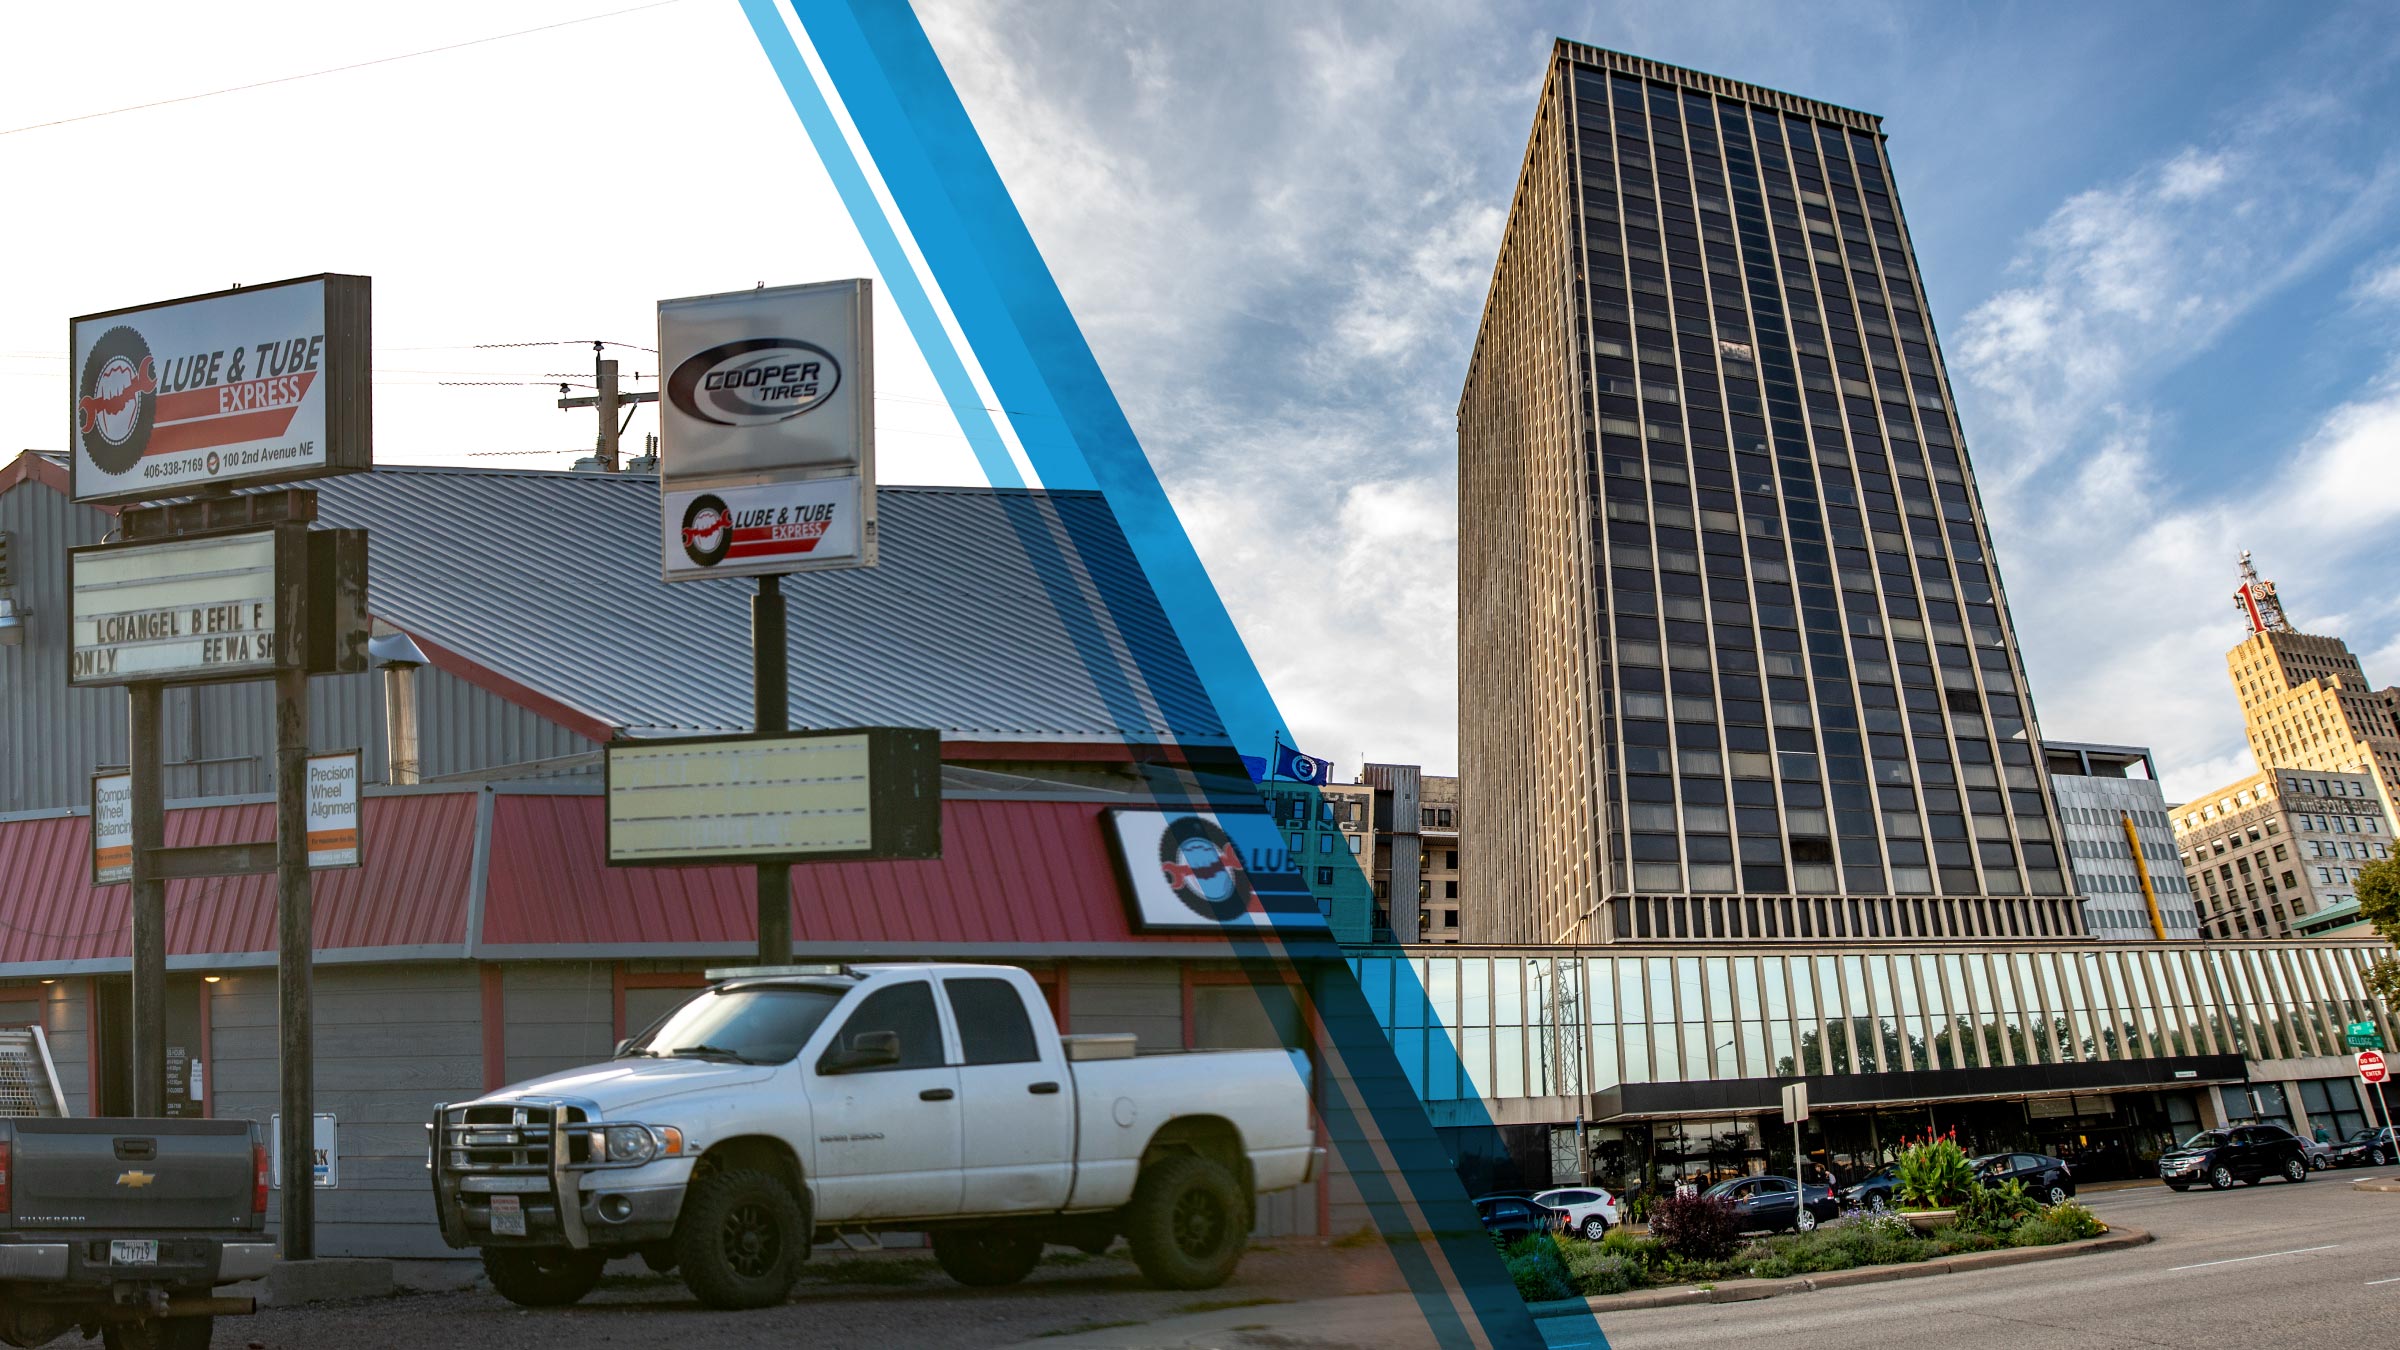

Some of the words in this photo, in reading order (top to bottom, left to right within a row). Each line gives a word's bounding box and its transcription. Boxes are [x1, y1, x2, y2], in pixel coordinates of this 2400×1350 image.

[160, 350, 224, 394] LUBE
[226, 346, 245, 382] &
[255, 335, 324, 378] TUBE
[705, 362, 821, 391] COOPER
[218, 377, 300, 414] EXPRESS
[760, 381, 818, 401] TIRES
[143, 457, 204, 479] 406-338-7169
[223, 452, 239, 468] 100
[241, 448, 259, 465] 2nd
[261, 446, 297, 462] Avenue
[299, 441, 314, 457] NE
[735, 509, 774, 528] LUBE
[777, 507, 789, 523] &
[794, 503, 836, 522] TUBE
[771, 522, 825, 539] EXPRESS
[311, 766, 354, 782] Precision
[311, 783, 342, 799] Wheel
[97, 803, 124, 820] Wheel
[2288, 799, 2350, 814] MINNESOTA
